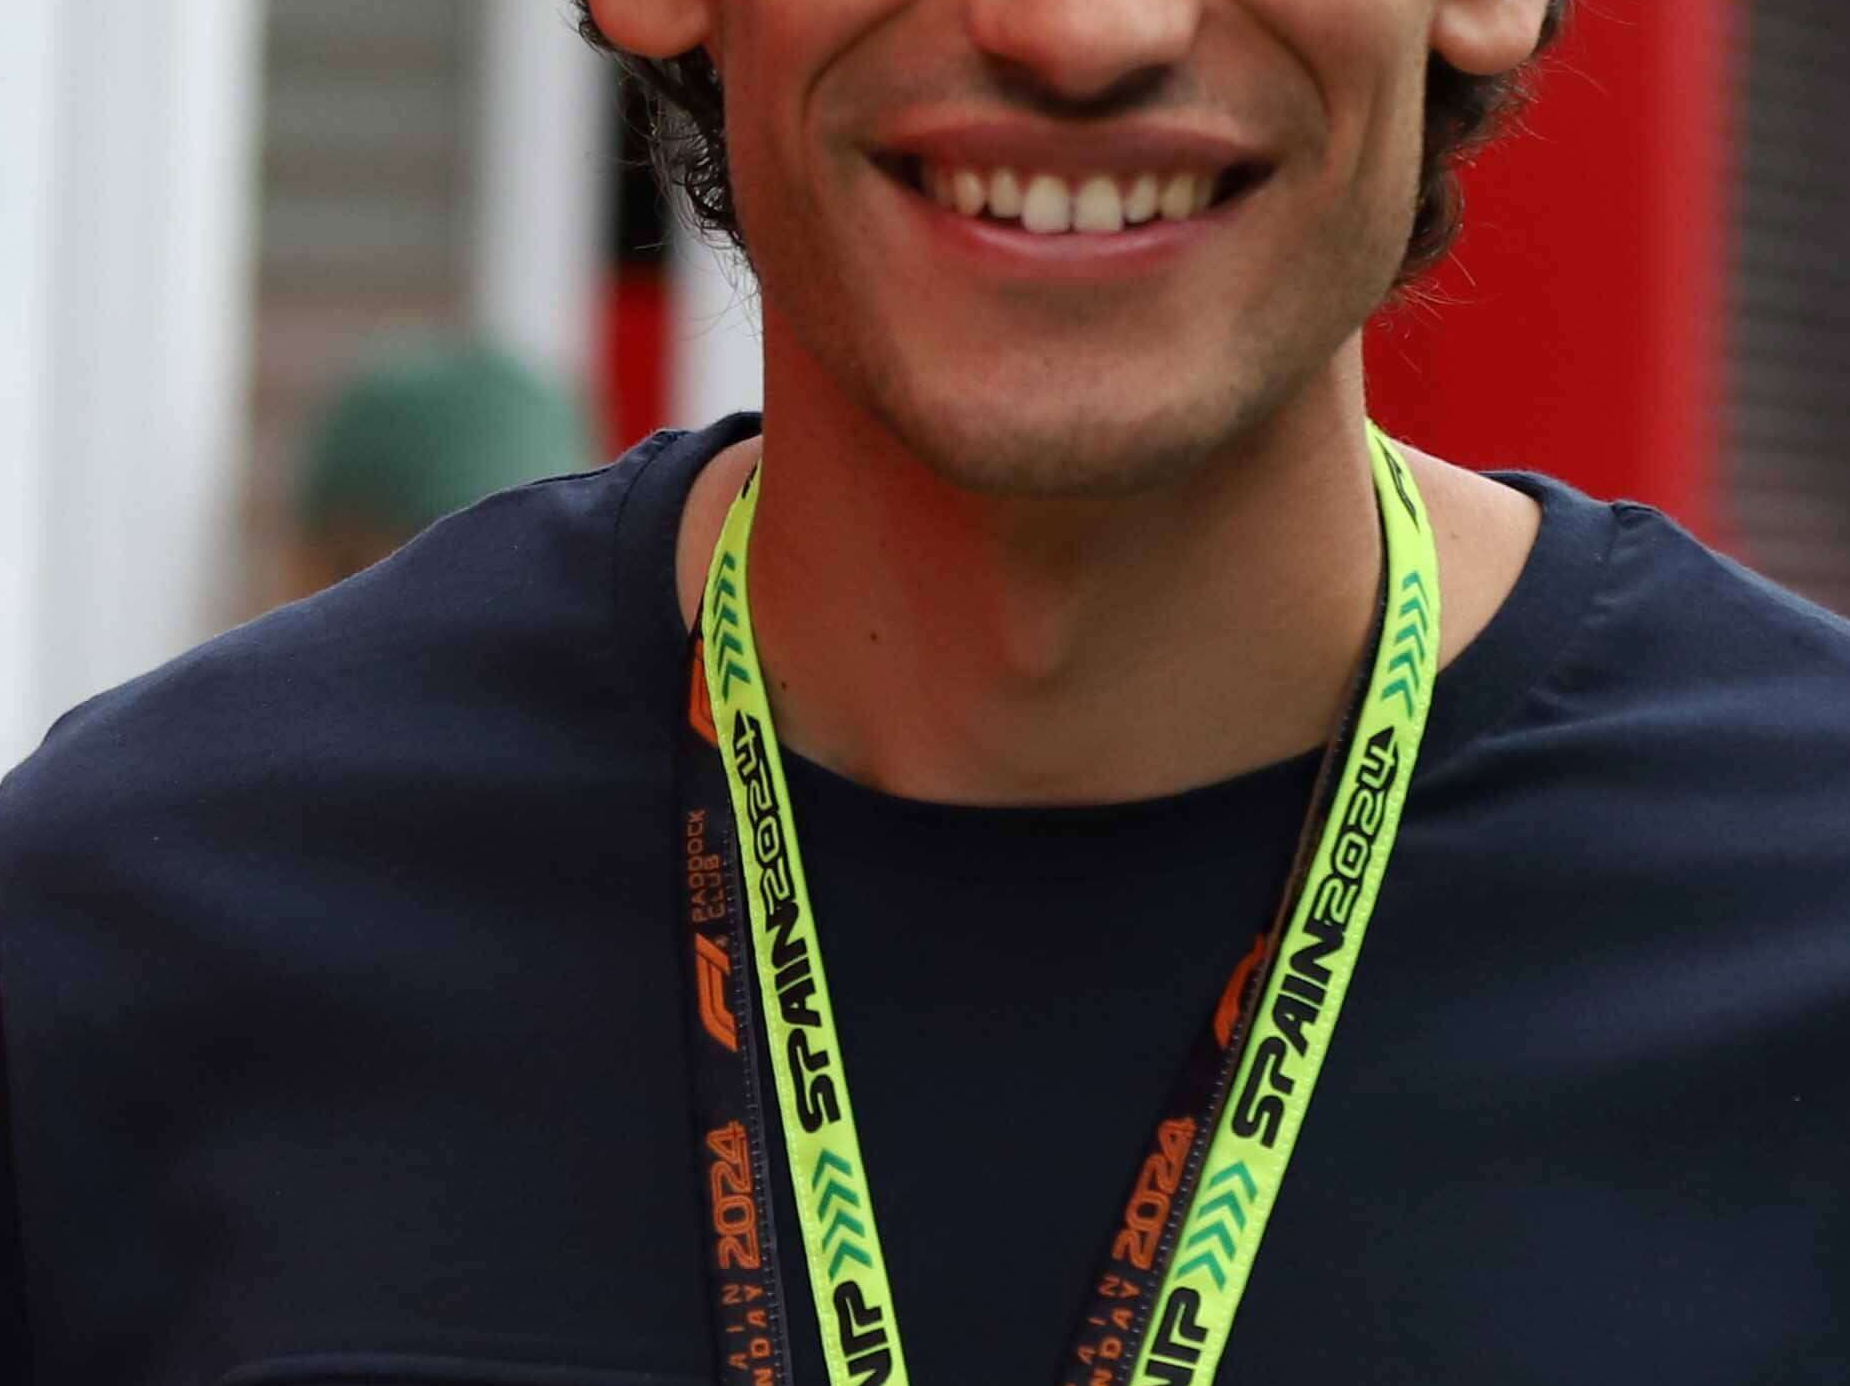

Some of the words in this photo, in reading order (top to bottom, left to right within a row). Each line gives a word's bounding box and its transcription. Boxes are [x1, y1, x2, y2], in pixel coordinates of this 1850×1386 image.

[687, 809, 706, 924] PADDOCK
[701, 853, 727, 920] CLUB
[706, 1120, 761, 1271] 2024
[1111, 1116, 1197, 1271] 2024
